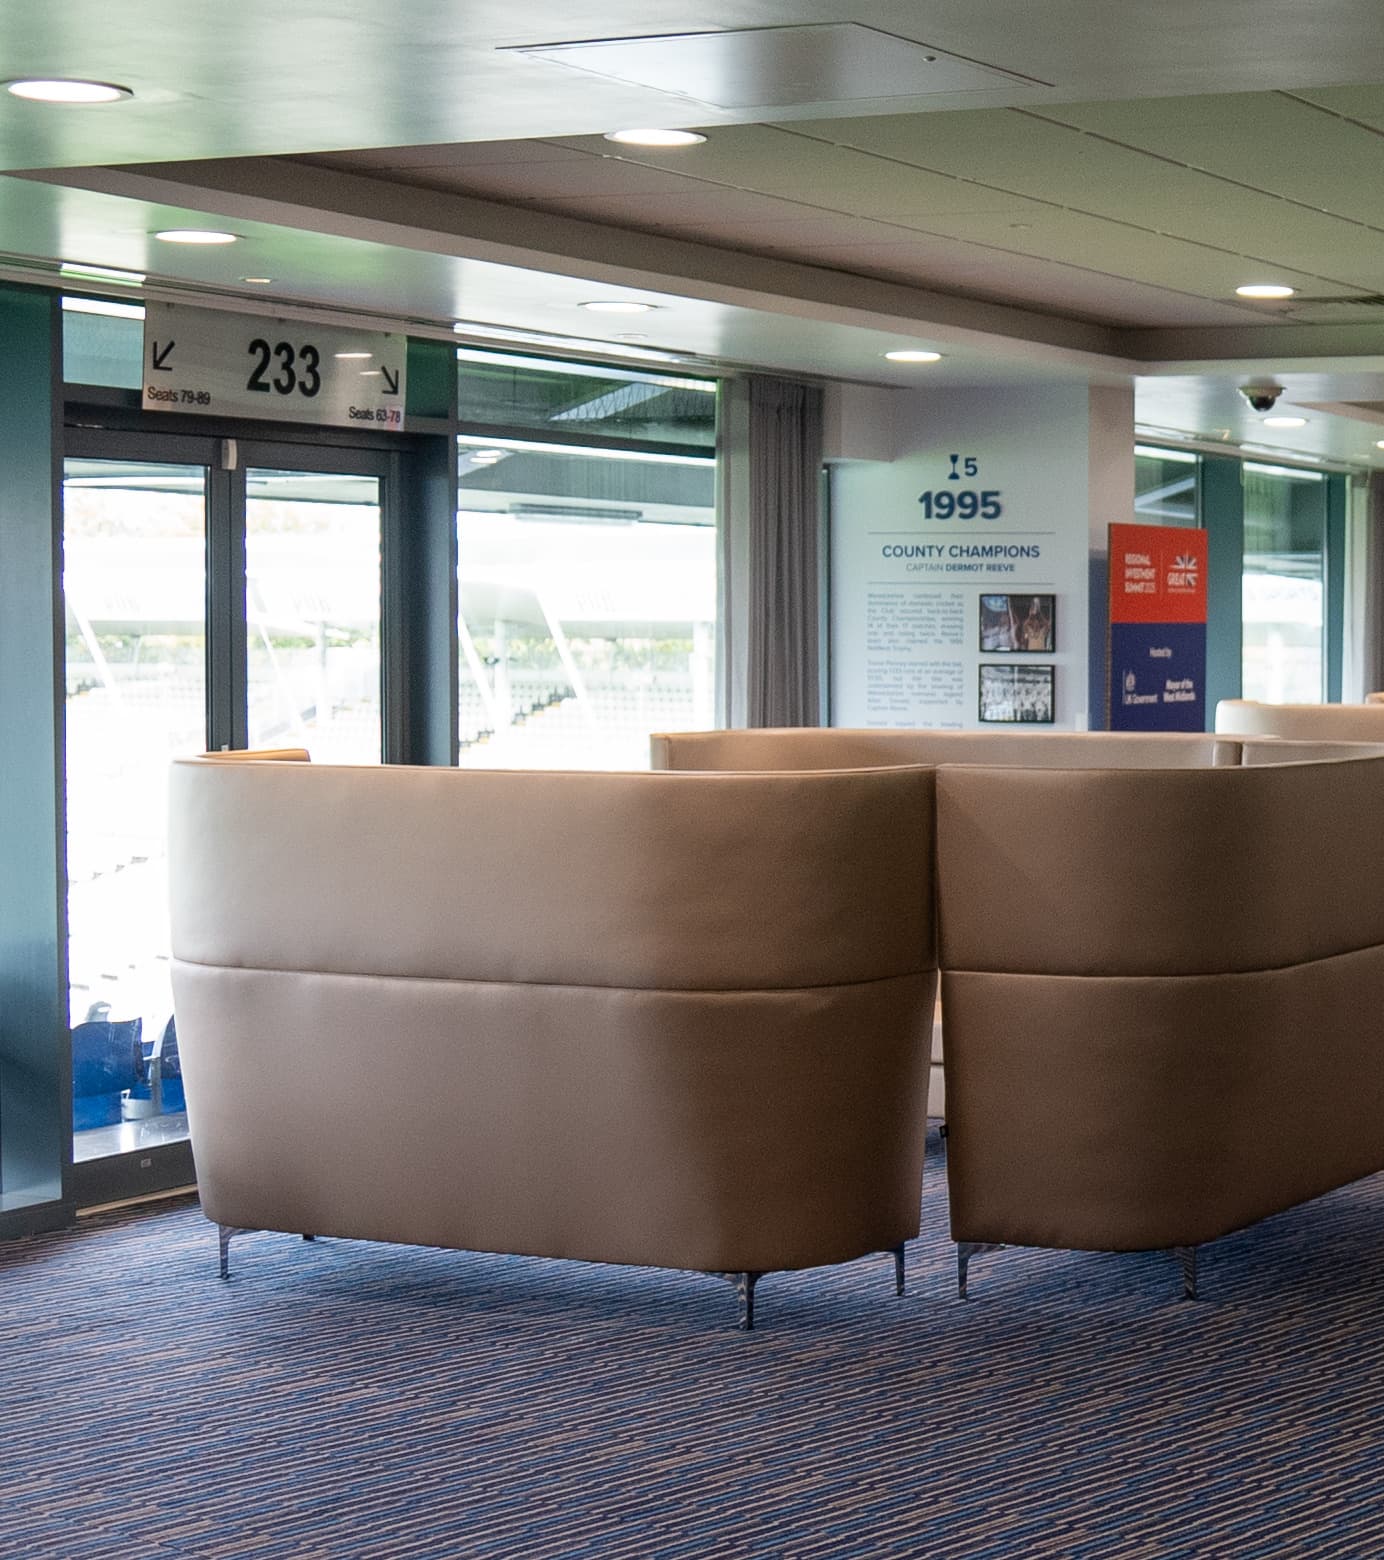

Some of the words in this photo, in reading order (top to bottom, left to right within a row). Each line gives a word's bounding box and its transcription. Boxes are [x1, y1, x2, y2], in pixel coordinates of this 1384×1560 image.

[246, 338, 321, 398] 233
[147, 387, 178, 403] Seats
[181, 389, 211, 405] 79-89
[348, 406, 374, 421] Seats
[376, 408, 401, 423] 63-78
[963, 457, 978, 477] 5
[918, 490, 1002, 520] 1995
[882, 545, 944, 558] COUNTY
[948, 545, 1040, 558] CHAMPIONS
[906, 563, 943, 572] CAPTAIN
[945, 563, 983, 572] DERMOT
[986, 563, 1015, 572] REEVE
